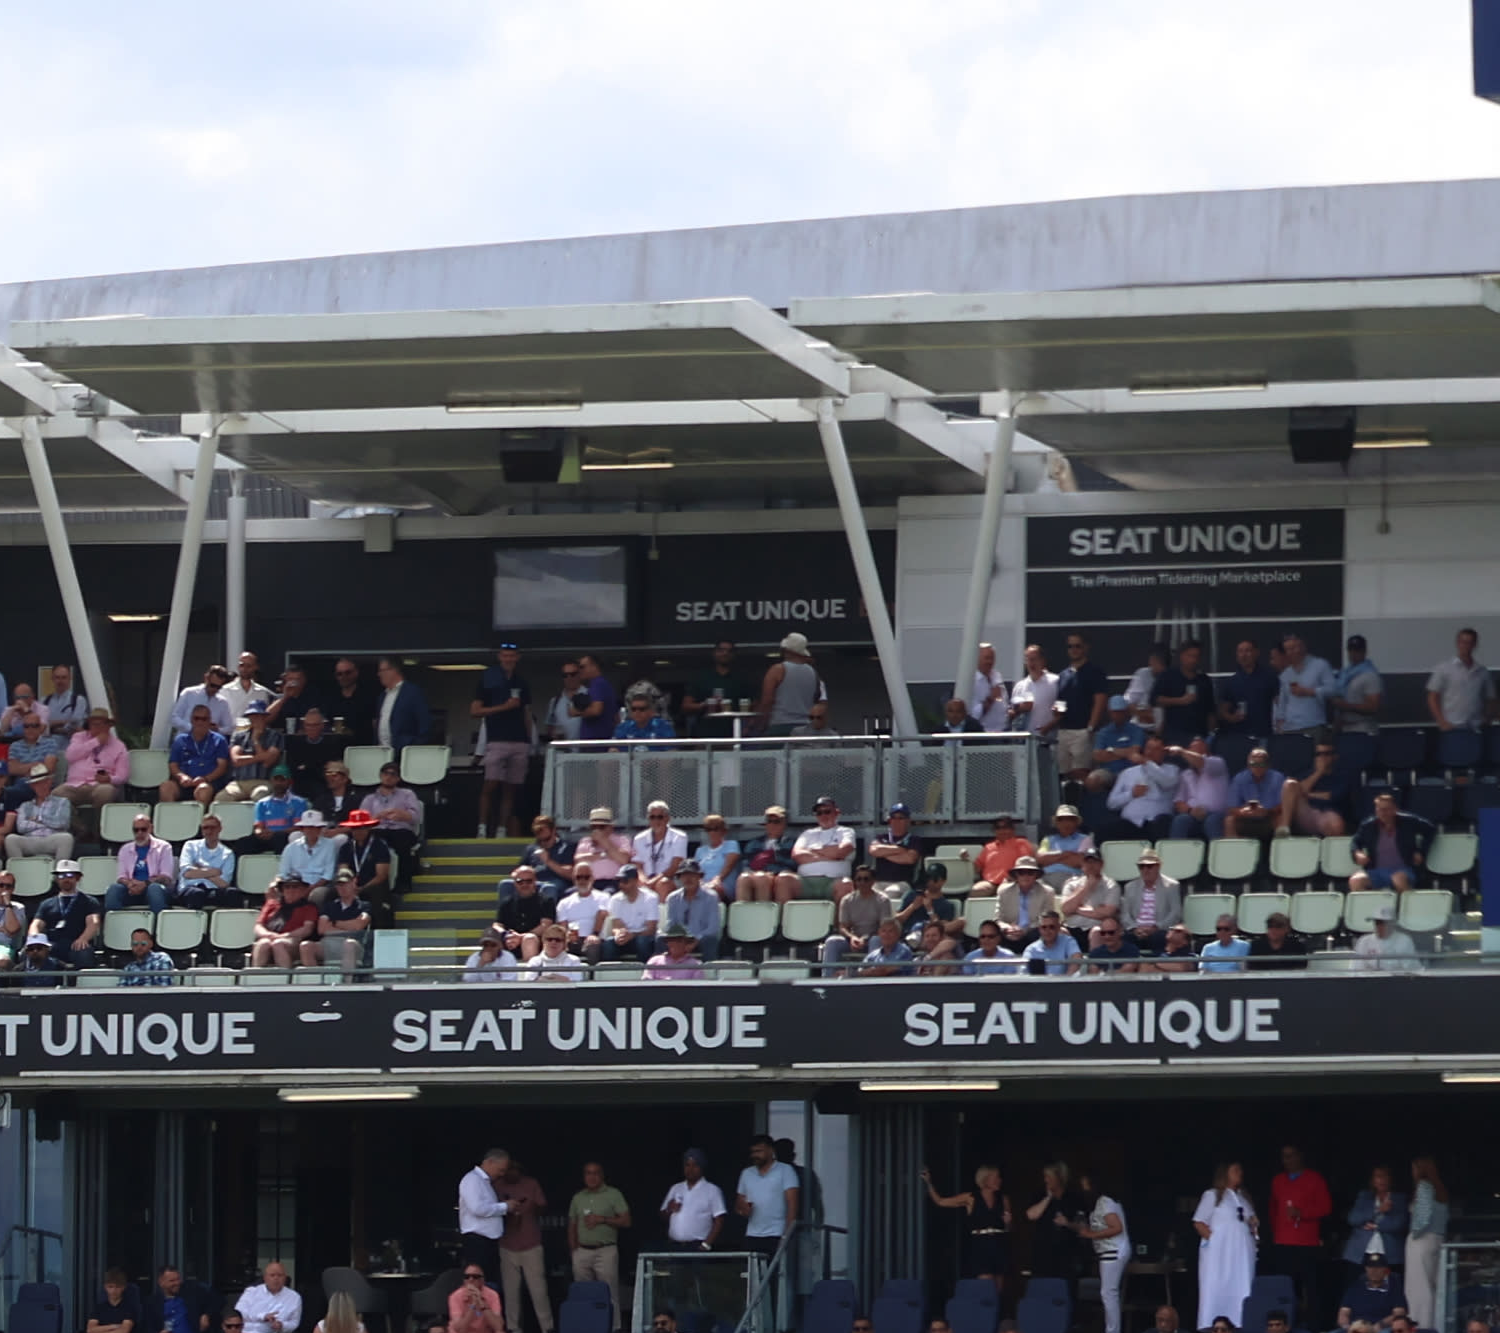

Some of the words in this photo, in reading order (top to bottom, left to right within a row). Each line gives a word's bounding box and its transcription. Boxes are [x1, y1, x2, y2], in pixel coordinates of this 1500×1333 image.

[1069, 526, 1159, 556] SEAT
[1164, 523, 1301, 554] UNIQUE
[1219, 570, 1301, 584] Marketplace
[676, 601, 741, 621] SEAT
[745, 599, 847, 621] UNIQUE
[42, 1013, 254, 1060] UNIQUE
[393, 1008, 535, 1052] SEAT
[548, 1006, 765, 1055] UNIQUE
[904, 1002, 1047, 1045] SEAT
[1060, 1000, 1279, 1048] UNIQUE
